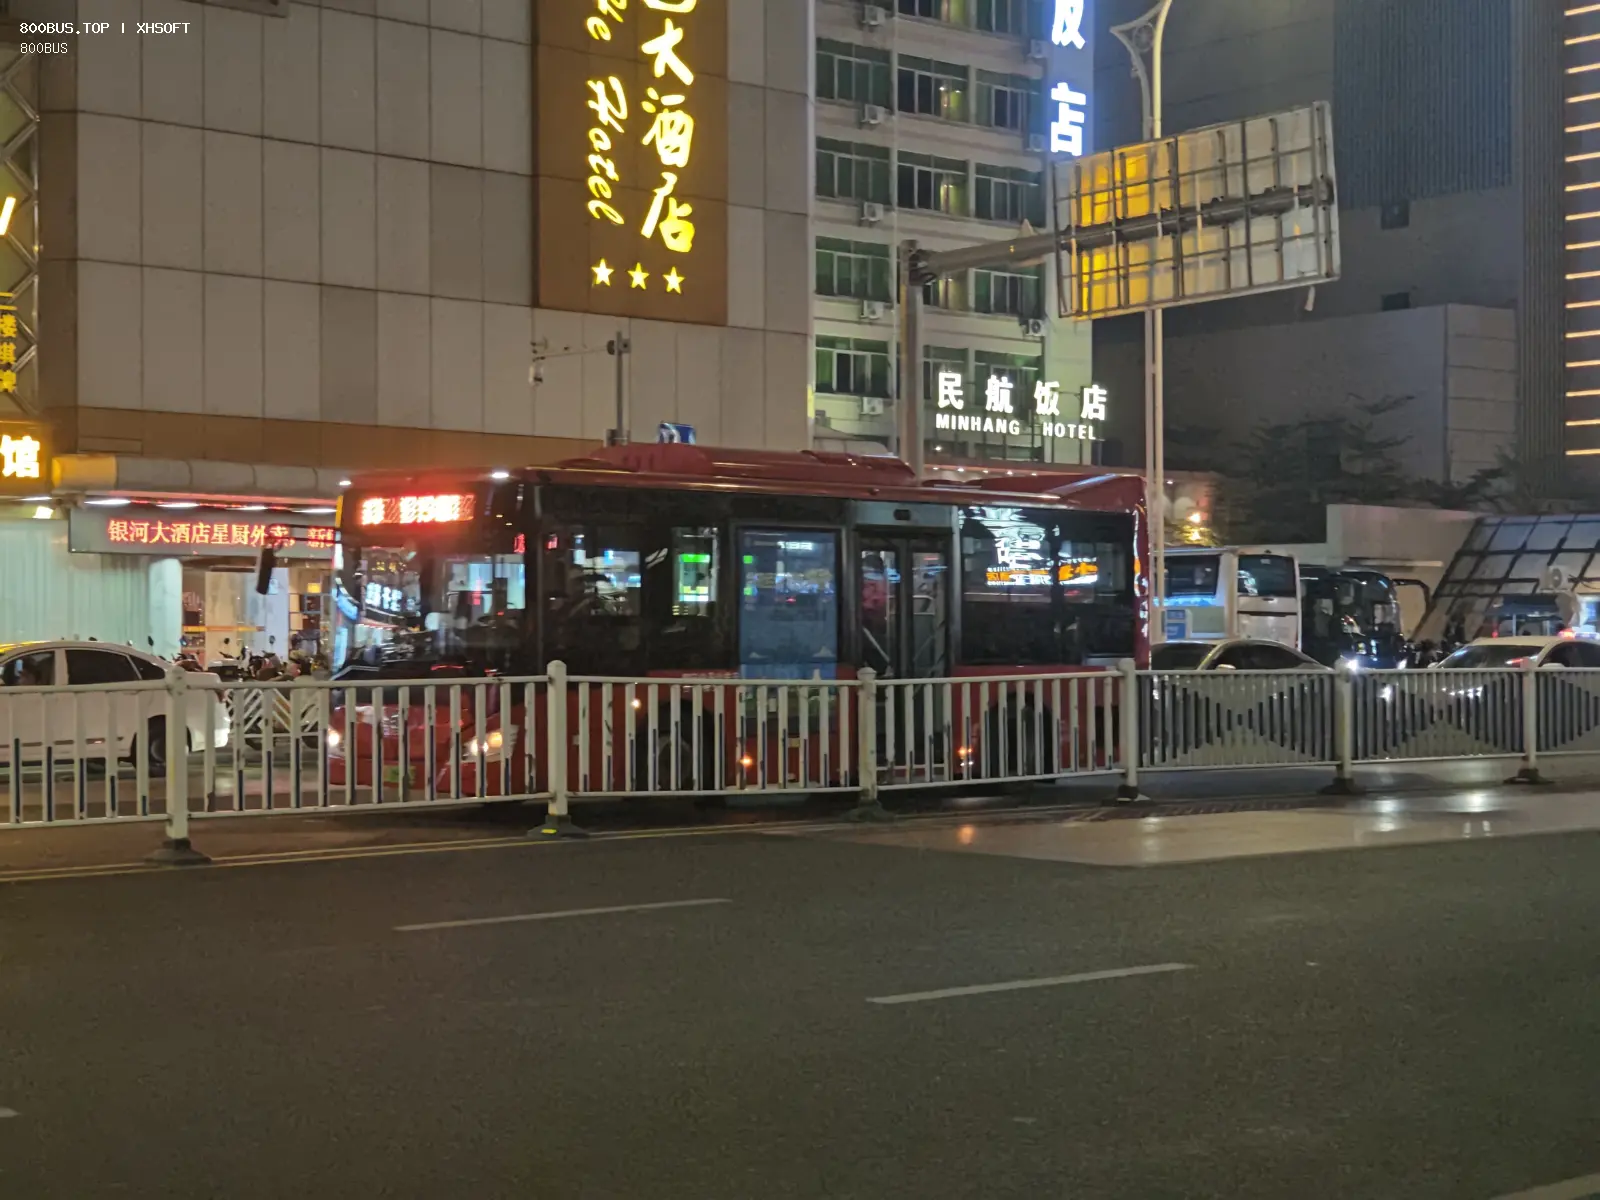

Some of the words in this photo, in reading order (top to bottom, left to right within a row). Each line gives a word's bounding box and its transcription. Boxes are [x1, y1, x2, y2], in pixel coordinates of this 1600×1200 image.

[587, 75, 628, 225] Hotel
[641, 0, 696, 253] 大酒店
[937, 371, 1108, 421] 民航饭店
[935, 413, 1020, 436] MINHANG
[1042, 421, 1097, 441] HOTEL
[0, 434, 41, 479] 馆
